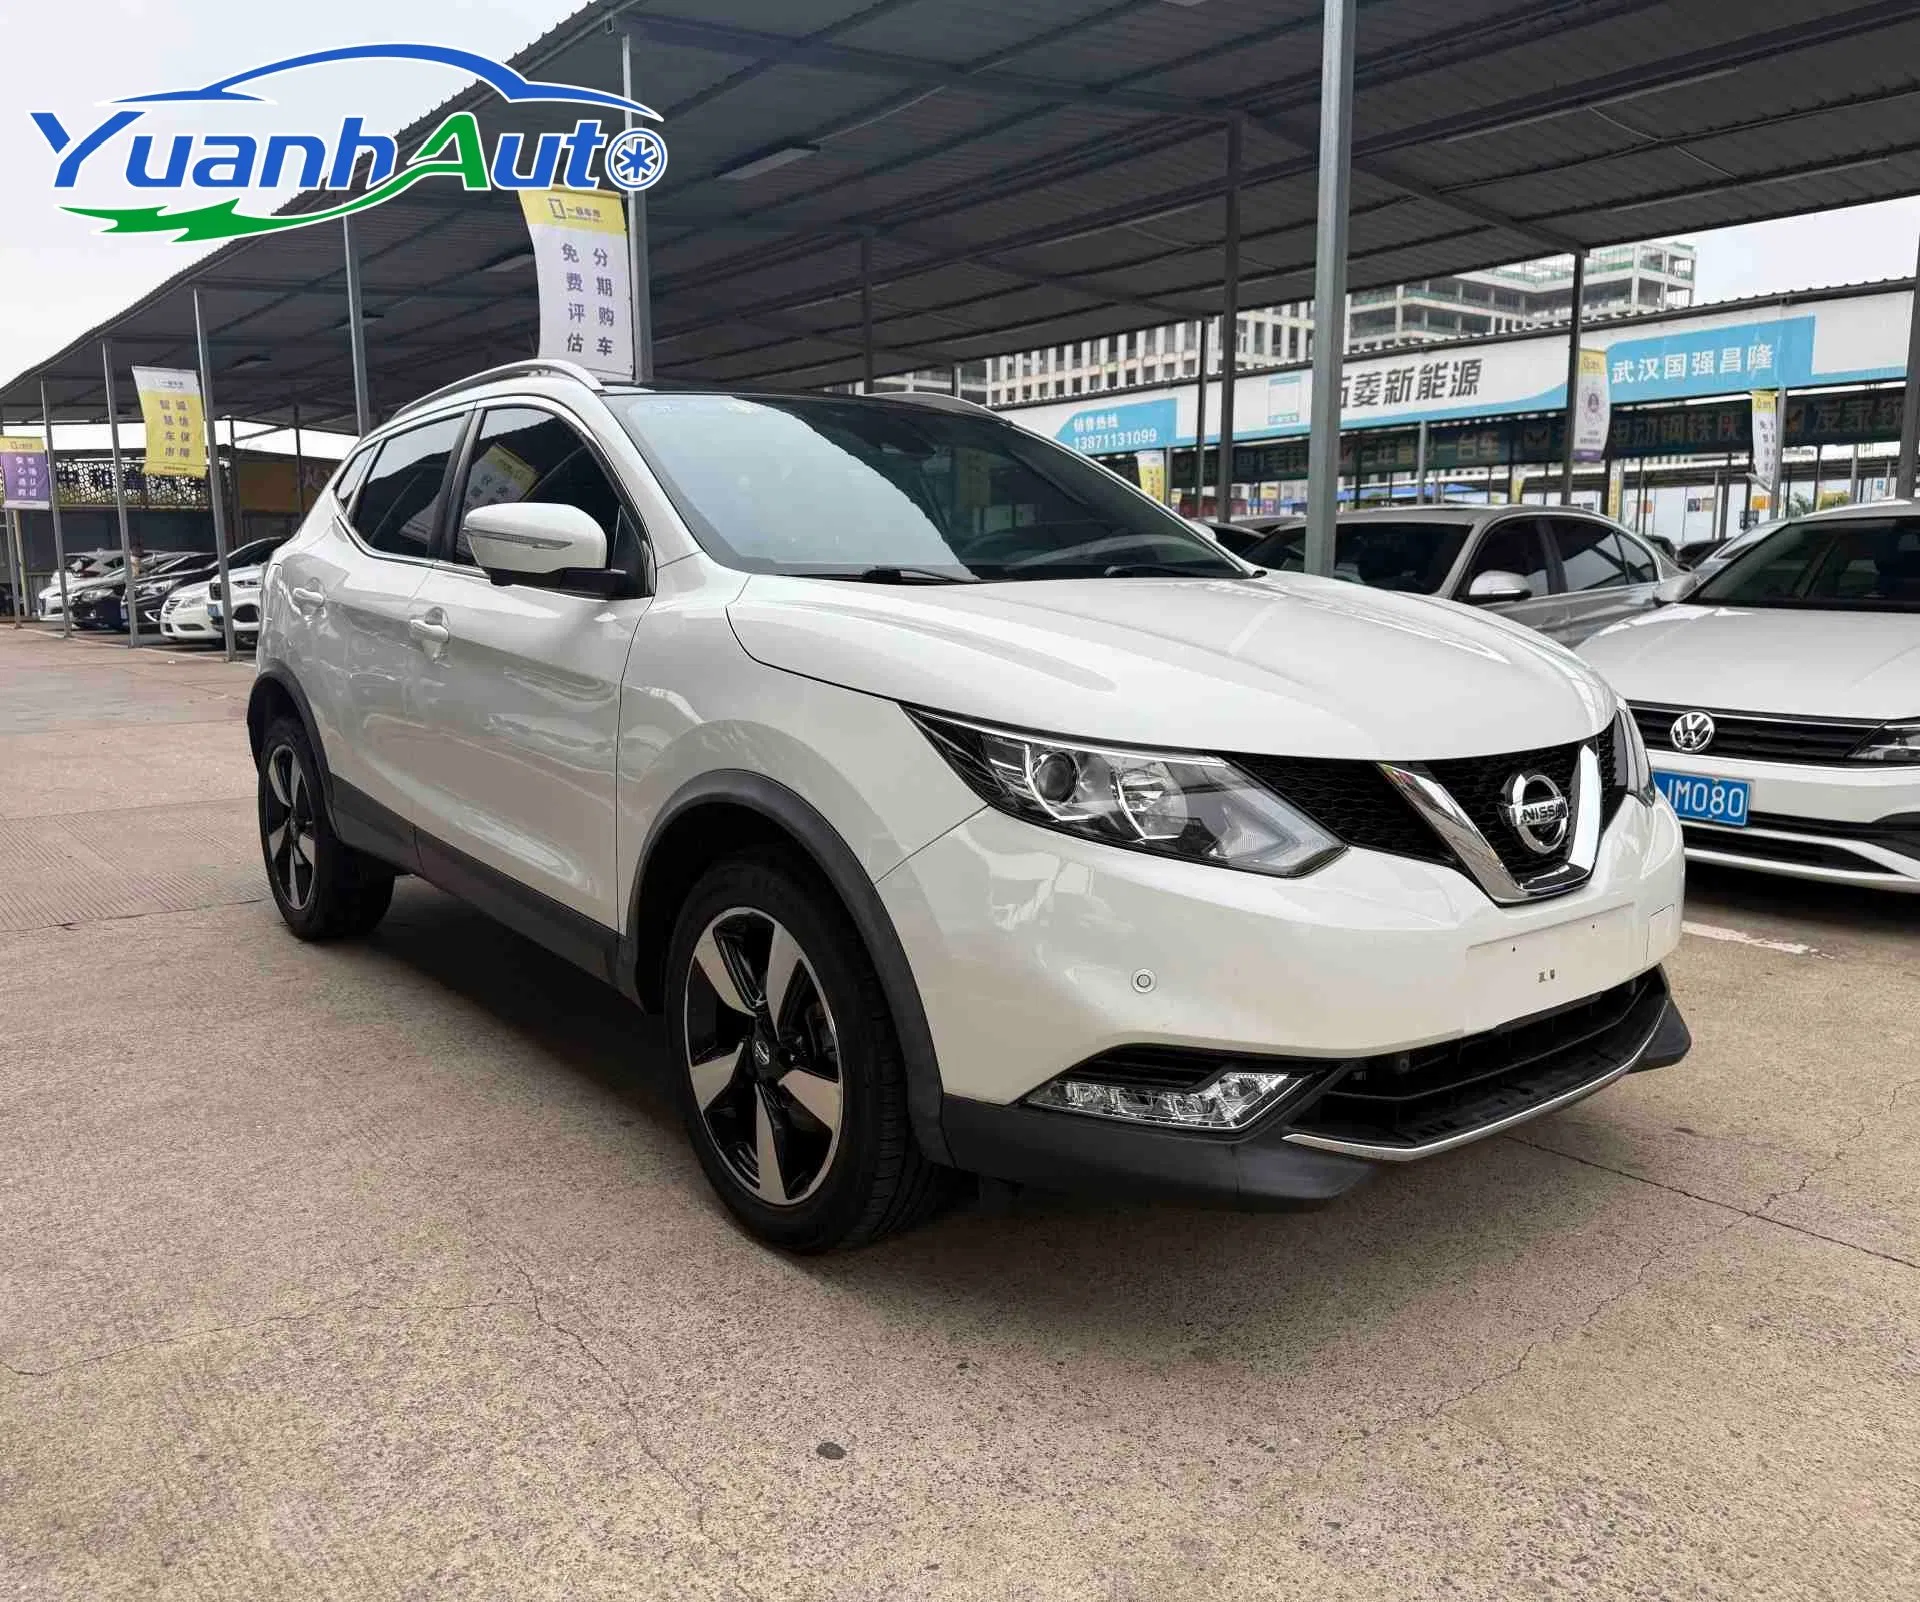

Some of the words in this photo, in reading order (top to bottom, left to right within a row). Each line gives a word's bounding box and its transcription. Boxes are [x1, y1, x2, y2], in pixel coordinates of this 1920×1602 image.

[561, 243, 585, 353] 免费评估
[592, 248, 614, 356] 分期购车
[1611, 343, 1773, 384] 武汉国强昌隆
